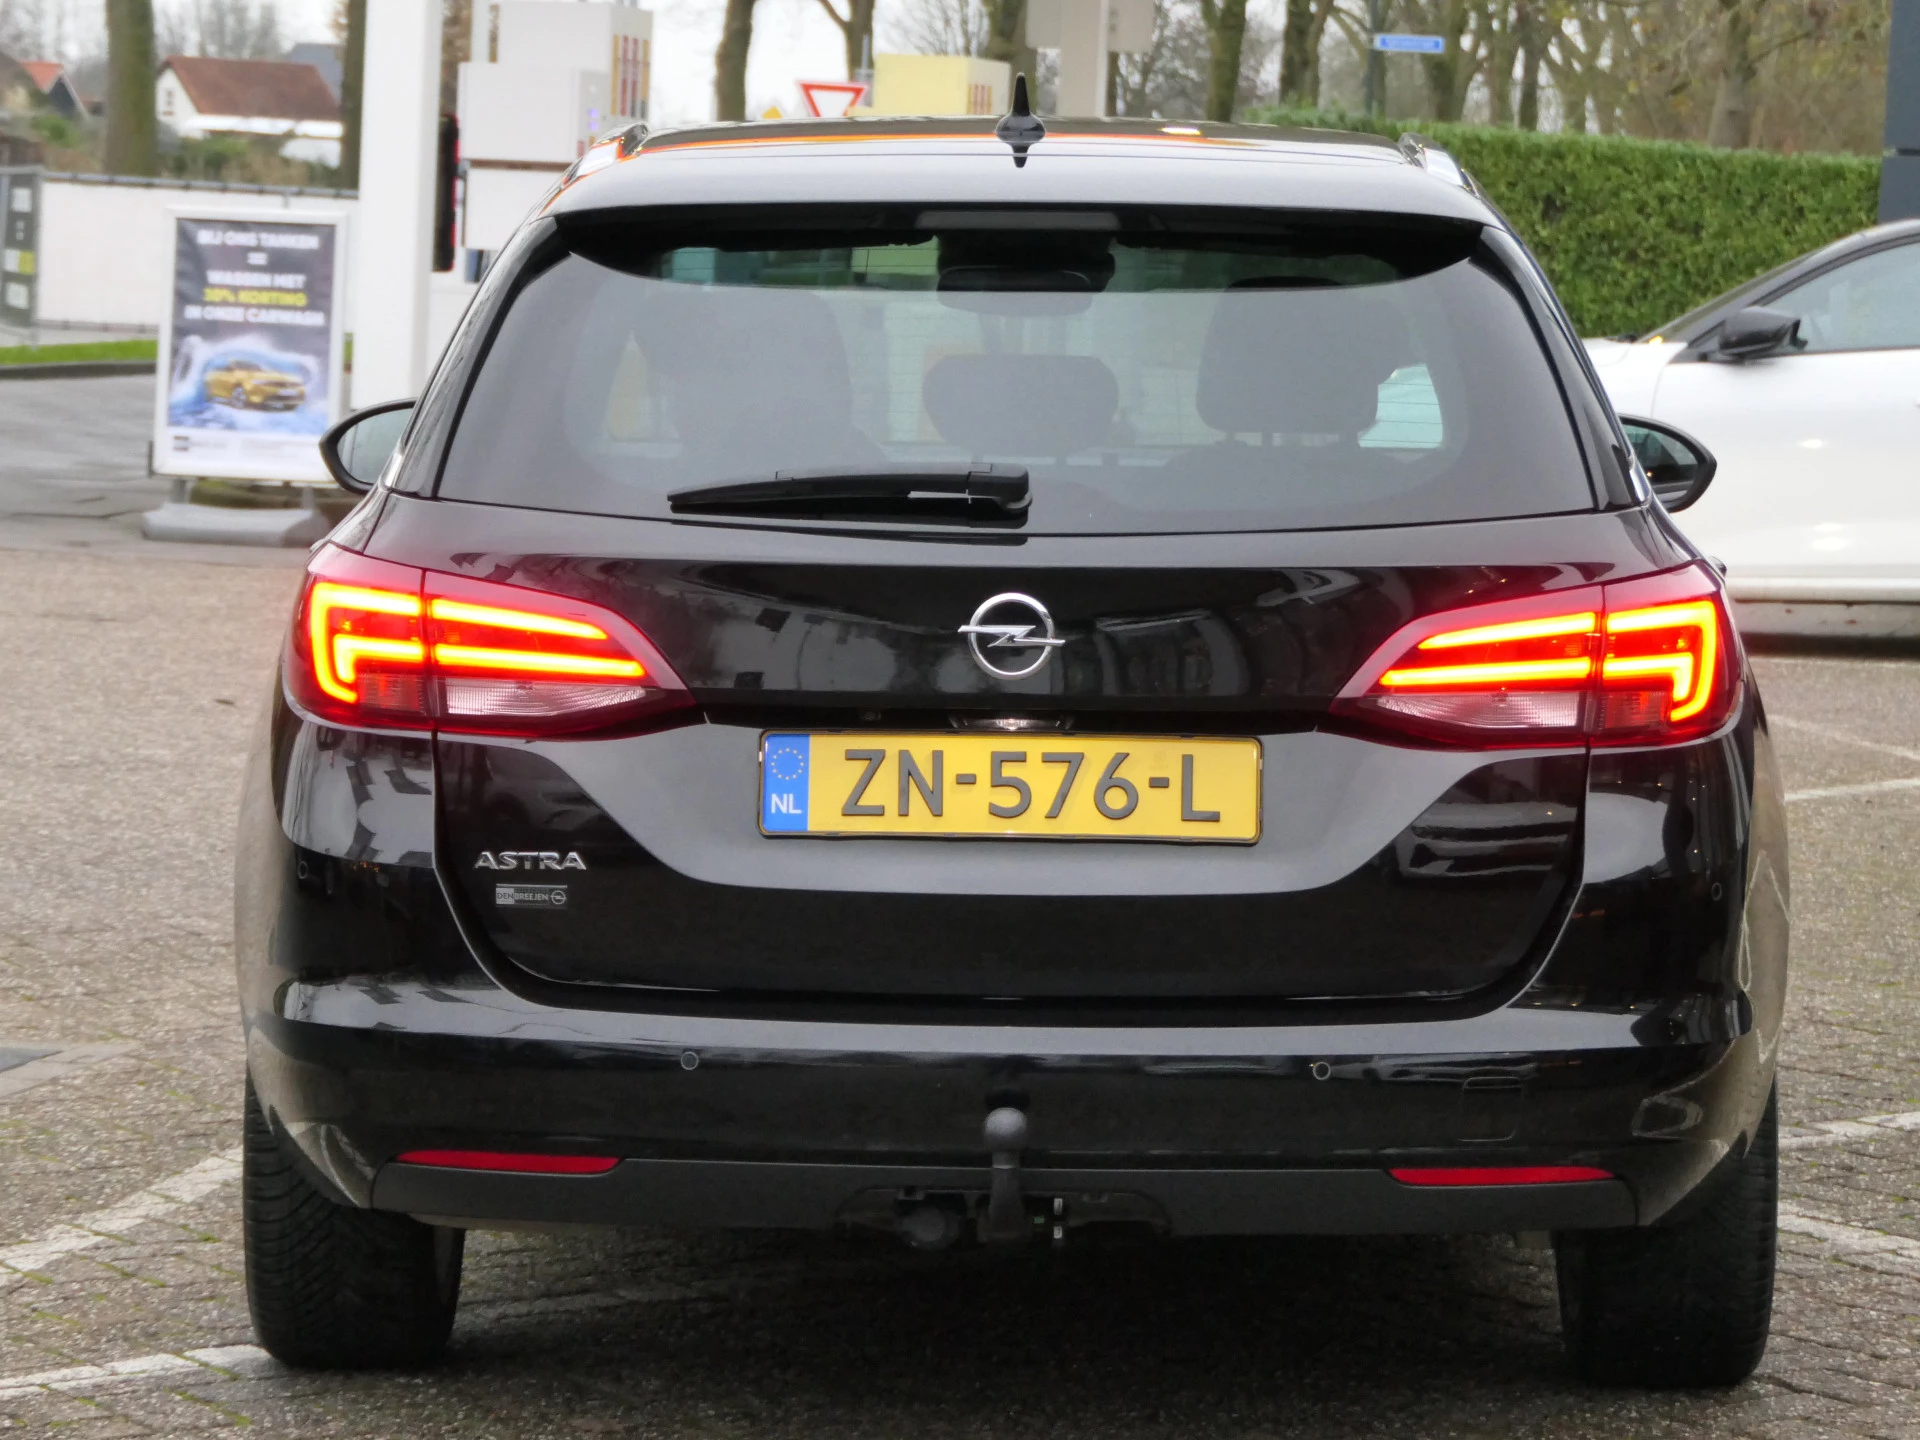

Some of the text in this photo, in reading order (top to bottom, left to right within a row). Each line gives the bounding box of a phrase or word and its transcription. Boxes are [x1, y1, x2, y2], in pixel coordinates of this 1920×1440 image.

[770, 749, 1221, 822] NL ZN-576-L
[473, 851, 587, 870] ASTRA
